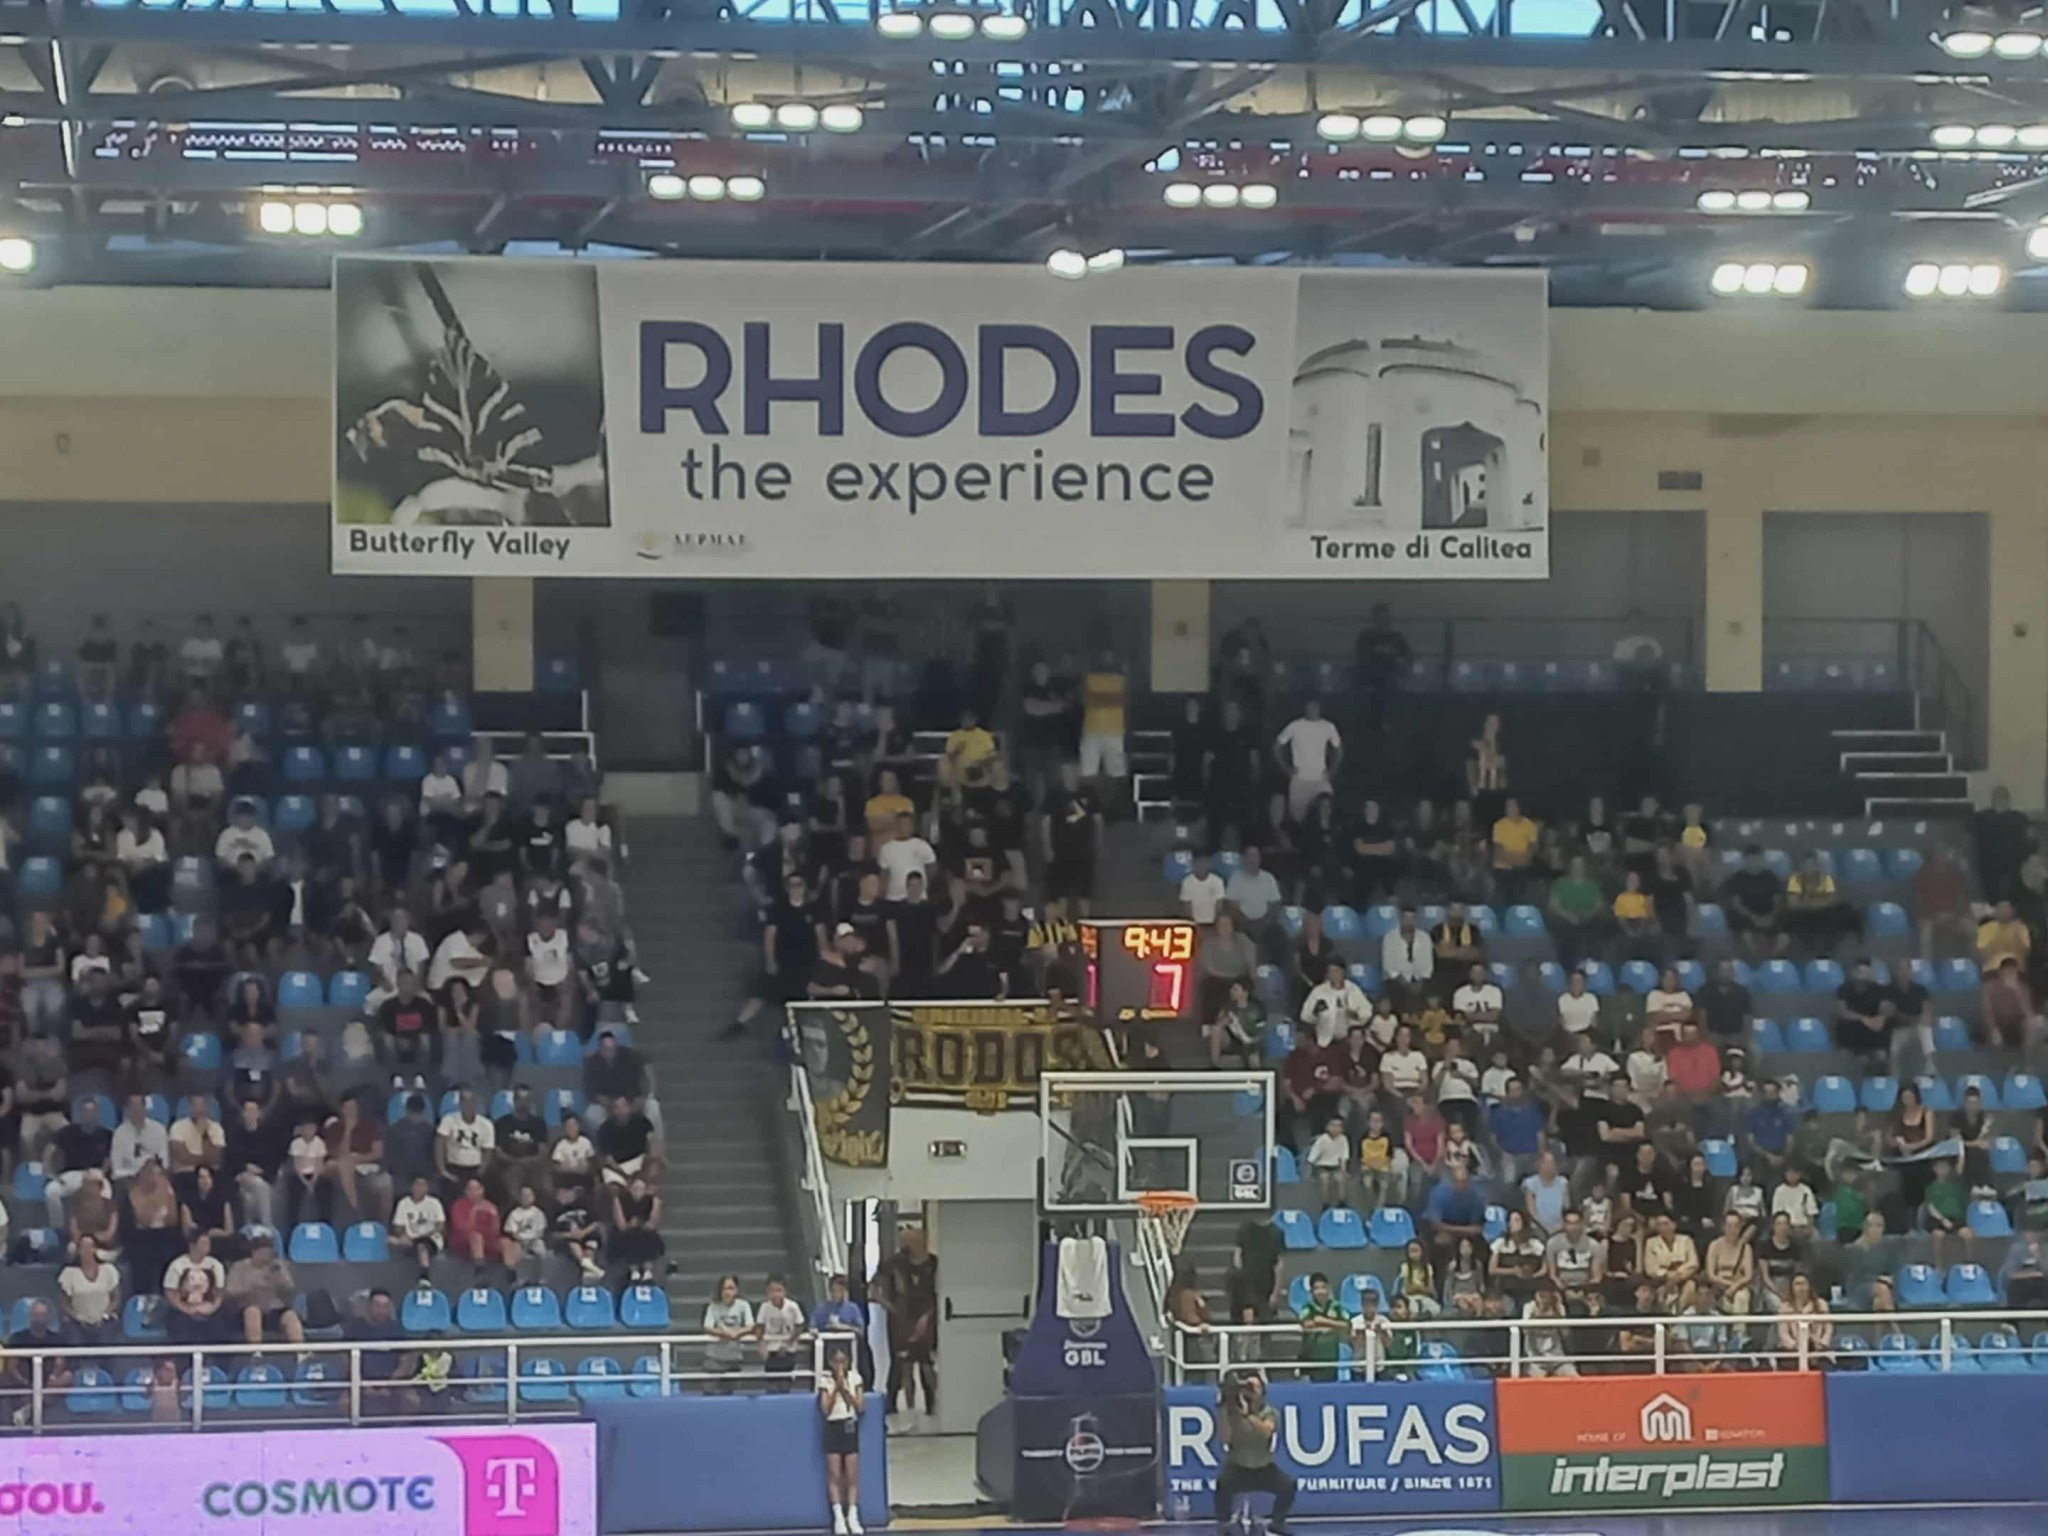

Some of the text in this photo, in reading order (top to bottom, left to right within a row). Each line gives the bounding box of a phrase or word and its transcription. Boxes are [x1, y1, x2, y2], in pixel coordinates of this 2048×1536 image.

[638, 320, 1265, 439] RHODES
[680, 443, 1215, 516] the experience
[349, 528, 571, 561] Butterfly Valley
[1310, 534, 1533, 560] Terme di Calitea
[1124, 927, 1193, 960] 9:43
[1154, 963, 1184, 1011] 7
[1064, 1350, 1107, 1367] GBL
[1168, 1403, 1491, 1468] RUFAS
[1550, 1451, 1785, 1497] interplast
[202, 1475, 436, 1518] COSMOTE
